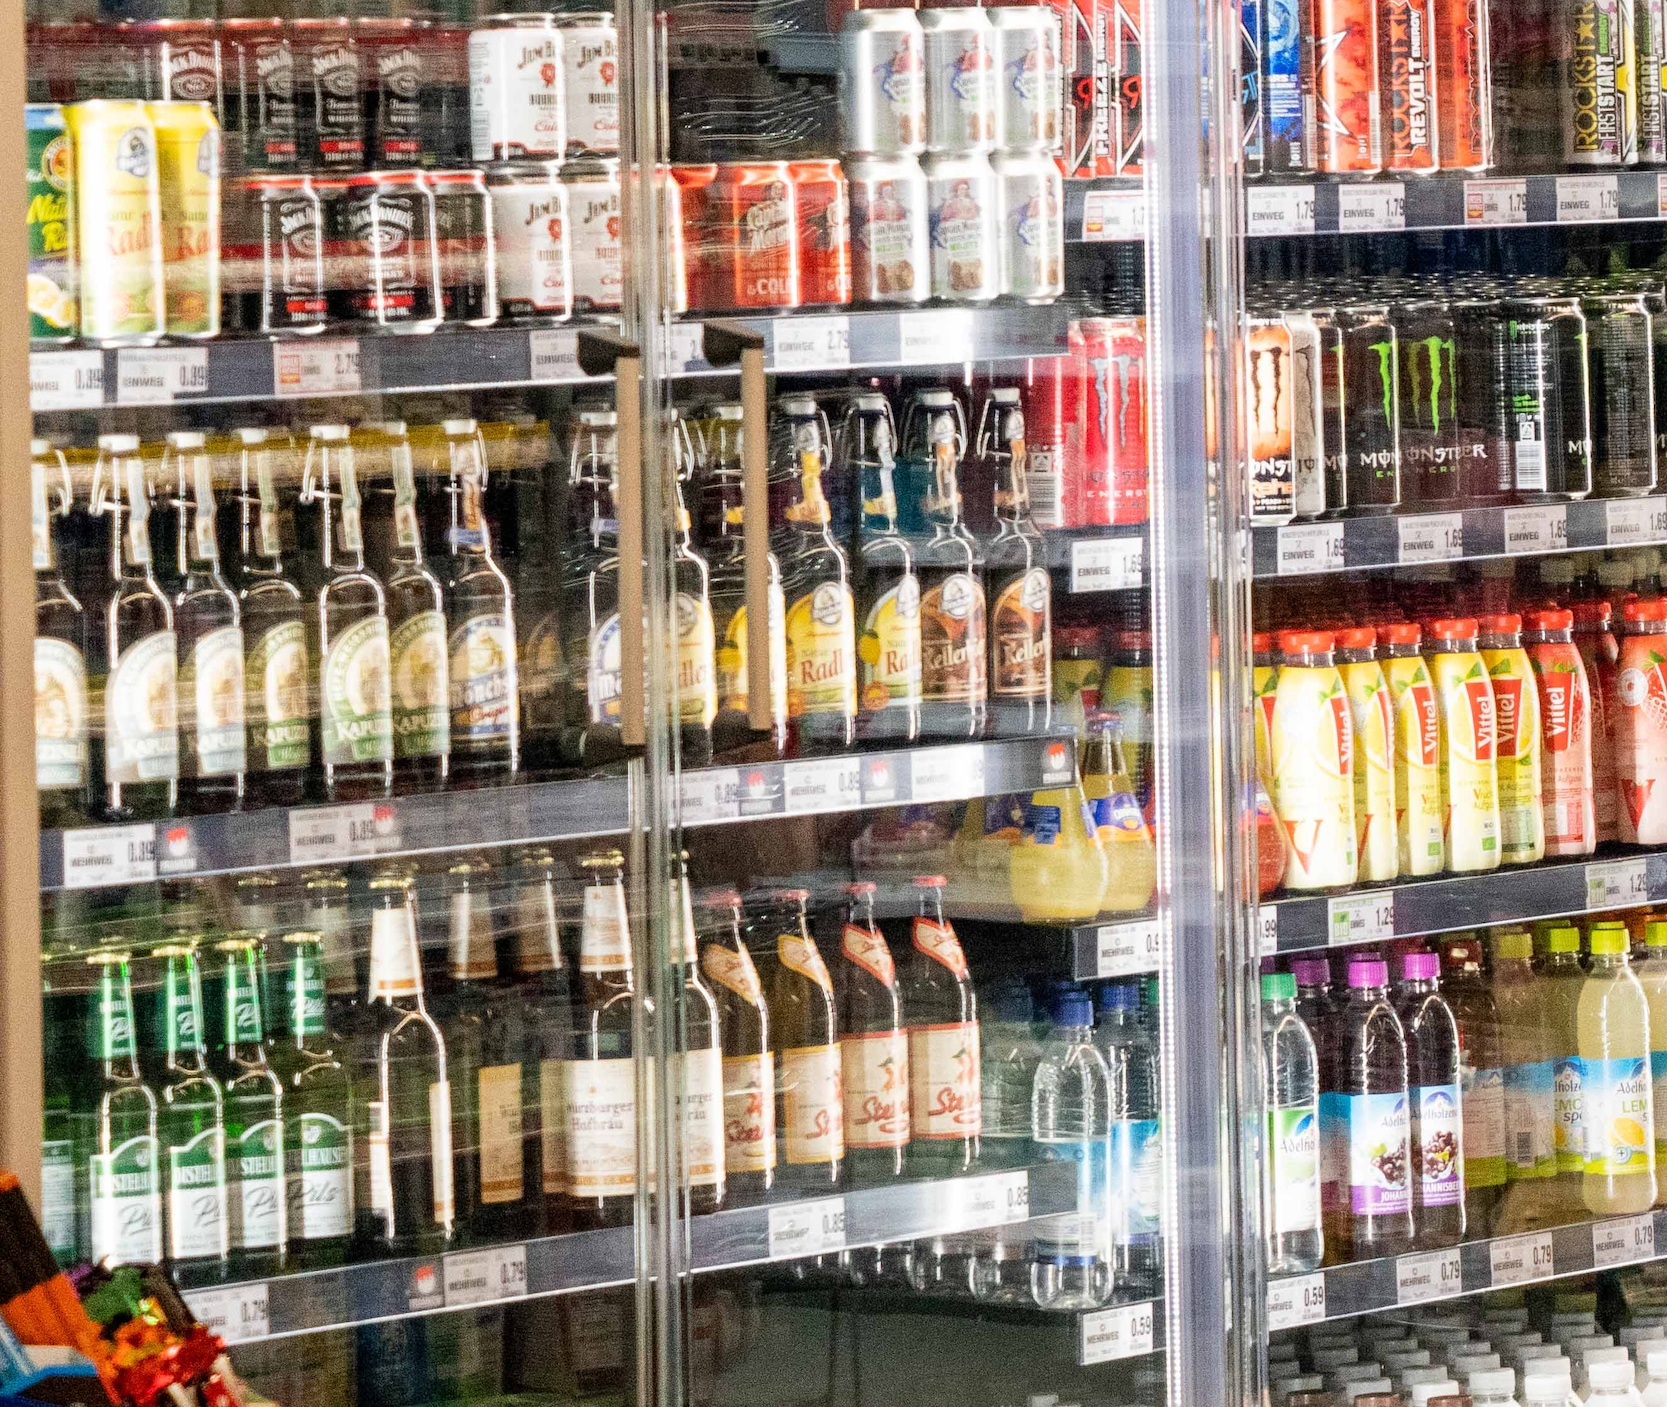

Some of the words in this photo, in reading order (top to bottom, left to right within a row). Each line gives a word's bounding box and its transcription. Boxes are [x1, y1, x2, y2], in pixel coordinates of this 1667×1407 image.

[1410, 10, 1422, 57] ENERGY
[1296, 200, 1315, 218] 1.79
[1386, 199, 1405, 217] 1.79
[1508, 194, 1527, 211] 1.79
[1560, 200, 1590, 210] EINWEG
[1600, 190, 1618, 209] 1.79
[1252, 211, 1284, 222] EINWEG
[1343, 209, 1375, 218] EINWEG
[1549, 519, 1568, 538] 1.69
[1650, 512, 1667, 531] 1.69
[1403, 541, 1434, 552] EINWEG
[1445, 529, 1463, 548] 1.69
[1509, 532, 1539, 542] EINWEG
[1282, 550, 1315, 560] EINWEG
[1325, 539, 1345, 557] 1.69
[1477, 693, 1493, 749] Vittel
[1497, 692, 1516, 746] Vittel
[1546, 685, 1566, 739] Vittel
[1424, 697, 1437, 755] Vittel
[1339, 709, 1352, 766] Vittel
[1375, 907, 1395, 927] 1.29
[1634, 1225, 1653, 1244] 0.79
[1533, 1245, 1552, 1264] 0.79
[1441, 1261, 1460, 1280] 0.79
[1493, 1259, 1523, 1272] MEHRWEG
[1400, 1275, 1431, 1287] MEHRWEG
[1304, 1286, 1324, 1307] 0.59
[1130, 1316, 1153, 1337] 0.59
